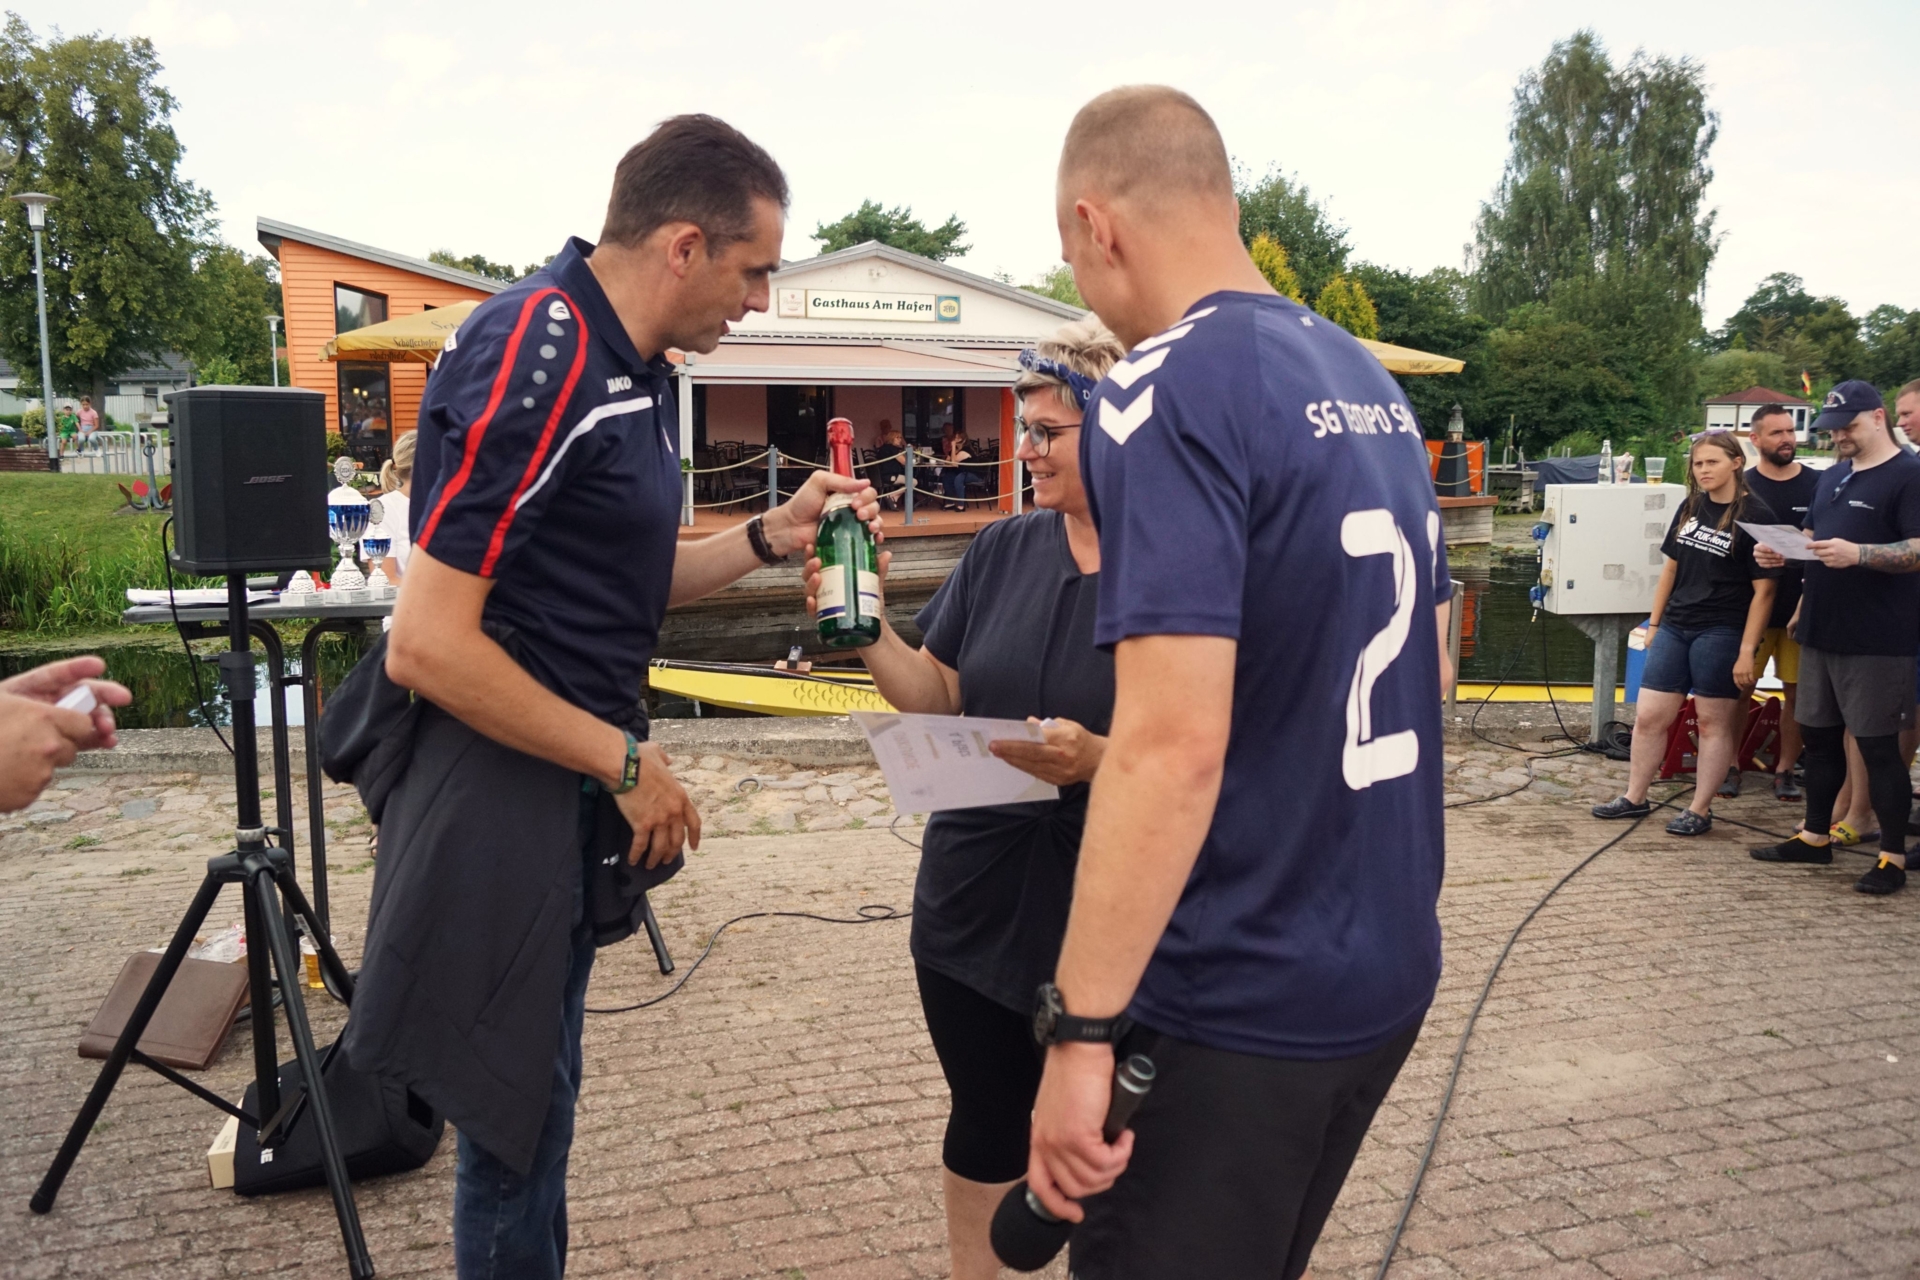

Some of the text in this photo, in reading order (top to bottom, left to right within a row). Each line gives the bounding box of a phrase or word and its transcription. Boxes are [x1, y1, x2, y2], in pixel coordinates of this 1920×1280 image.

[812, 297, 870, 310] Gasthaus
[872, 299, 893, 310] Am
[896, 300, 933, 313] Hafen
[1305, 400, 1343, 438] SG
[243, 474, 293, 485] BOSE
[1340, 508, 1440, 790] 2
